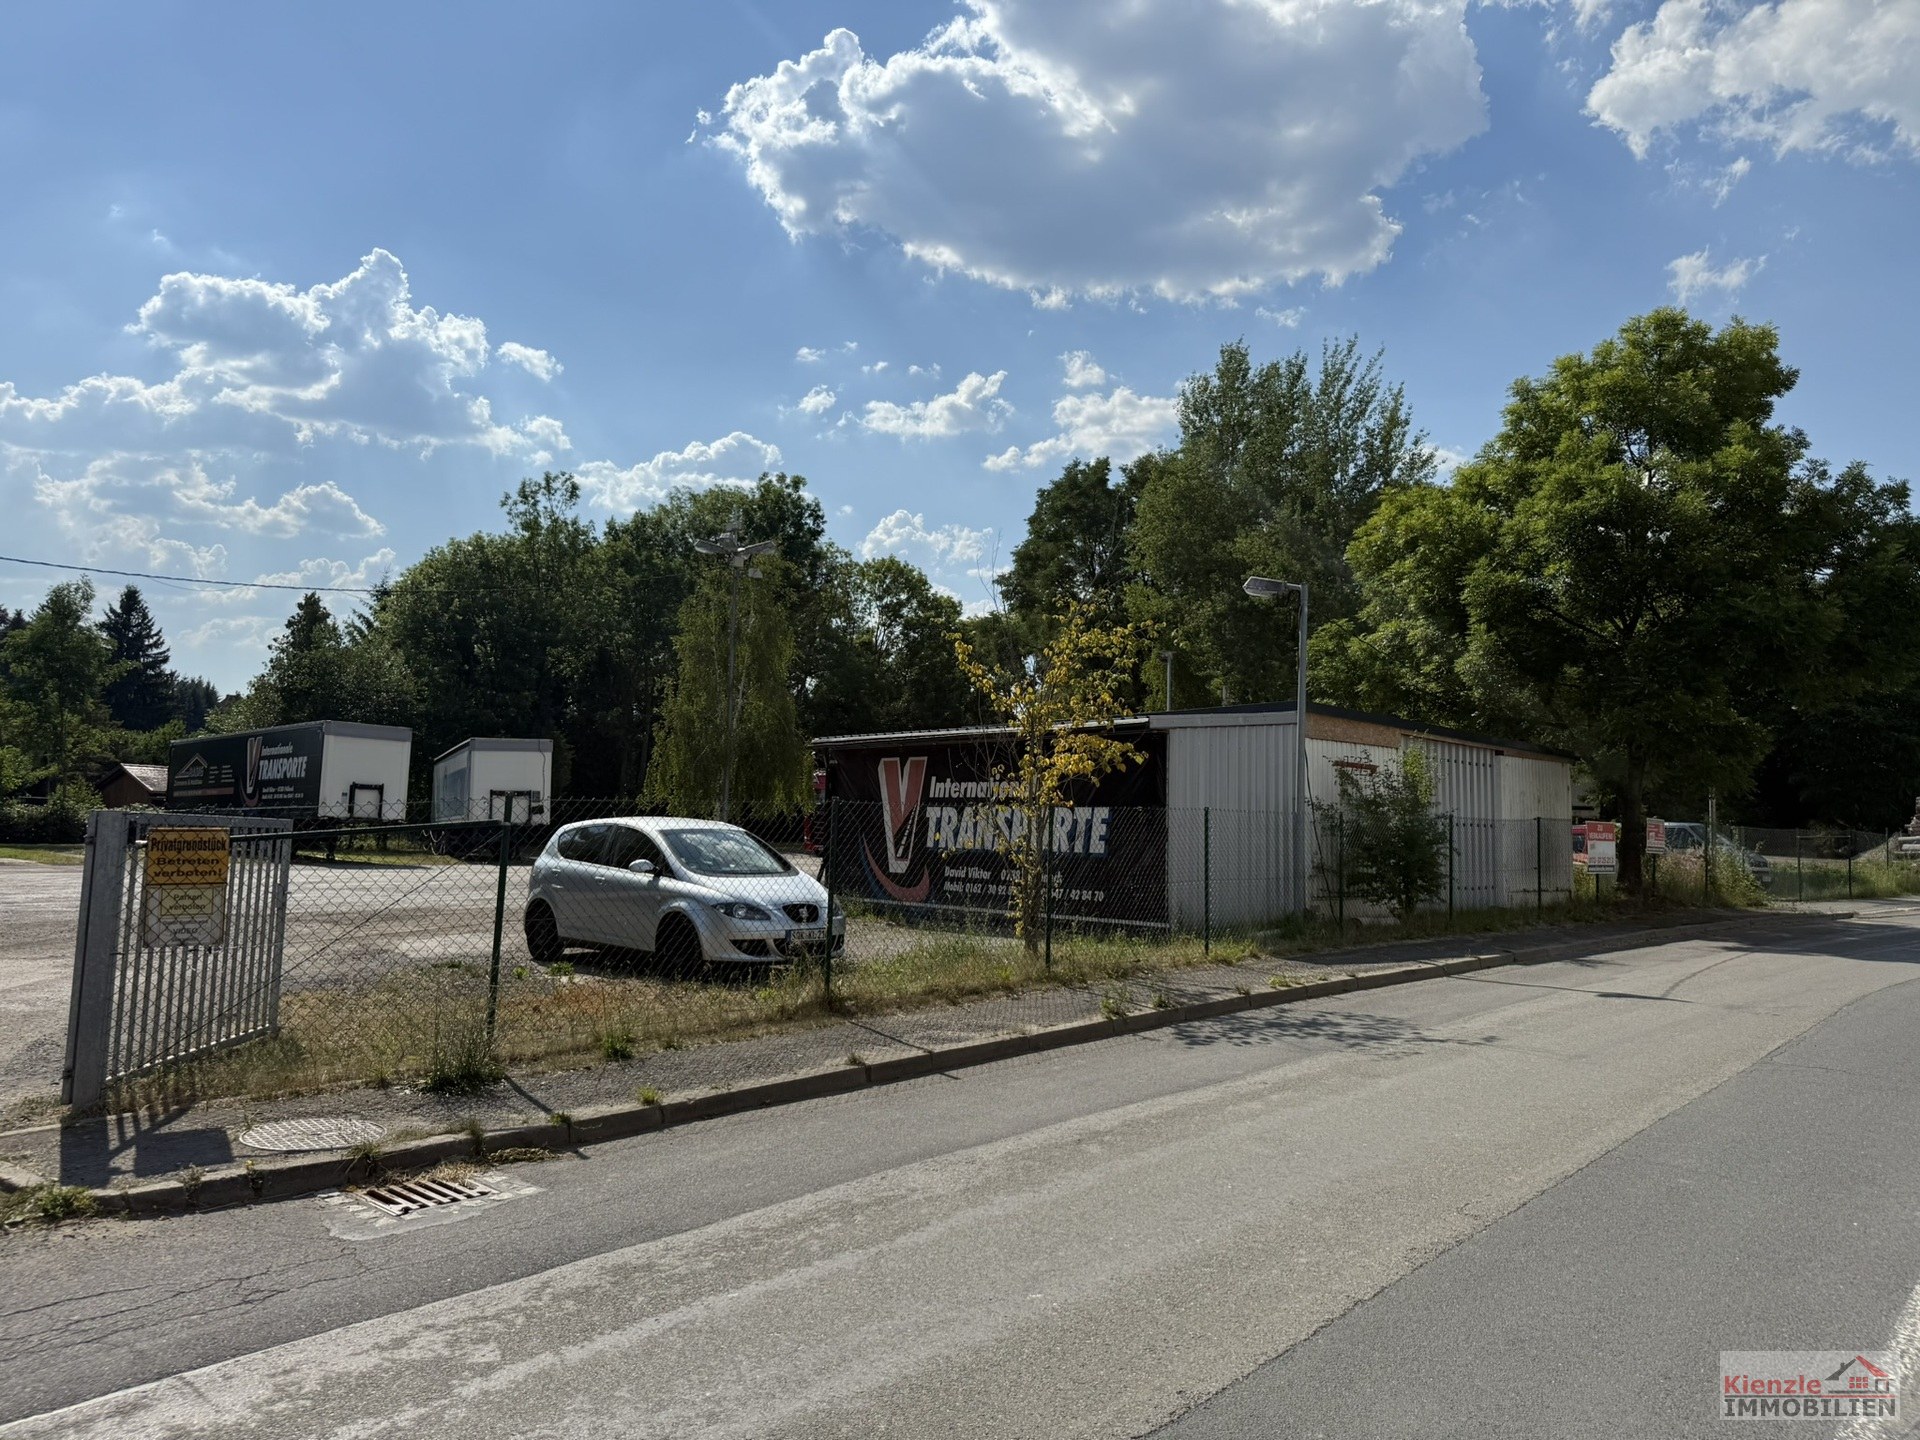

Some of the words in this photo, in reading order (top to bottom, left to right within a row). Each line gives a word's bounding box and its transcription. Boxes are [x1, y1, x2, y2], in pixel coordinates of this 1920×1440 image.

[259, 756, 307, 780] TRANSPORTE
[929, 776, 1041, 799] Internationl
[150, 837, 227, 853] Privatgrundstück
[156, 857, 220, 866] Betreten
[153, 868, 222, 877] verboten!
[944, 866, 967, 878] David
[968, 867, 992, 880] Viktor
[965, 883, 981, 893] 0162
[1070, 890, 1080, 900] 42
[1082, 890, 1092, 901] 84
[1094, 891, 1104, 902] 70
